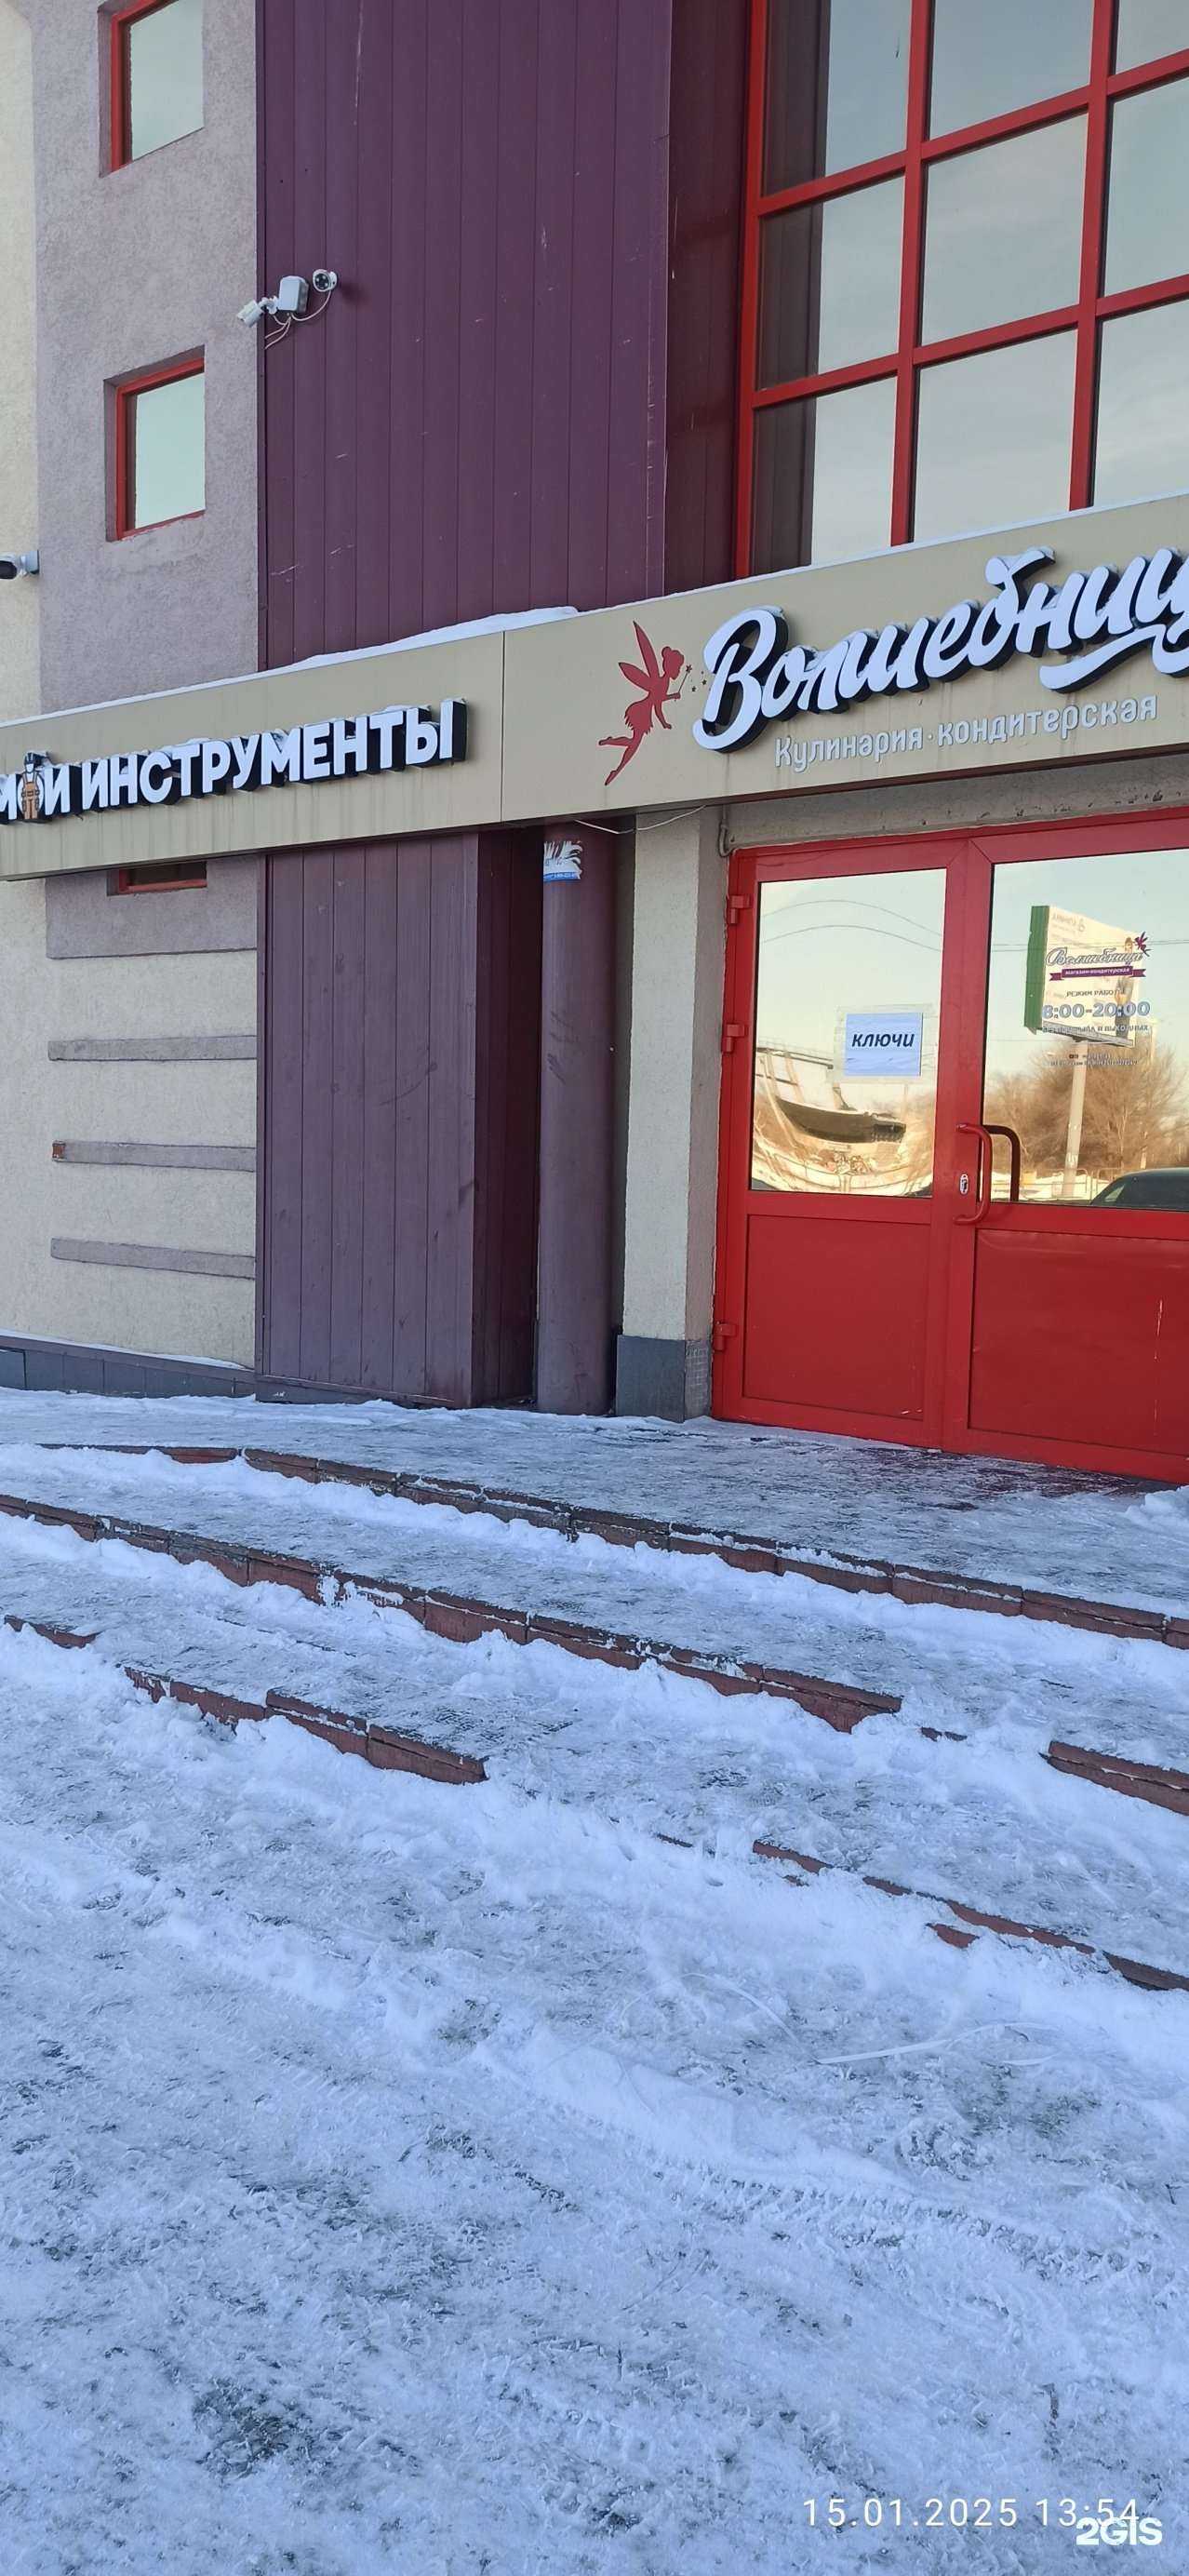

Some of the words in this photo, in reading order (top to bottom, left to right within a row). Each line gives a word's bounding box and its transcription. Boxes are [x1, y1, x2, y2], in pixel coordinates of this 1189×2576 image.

[82, 698, 463, 811] ИНСТРУМЕНТЫ
[774, 725, 924, 774] Кулинария
[937, 694, 1159, 750] кондитерская
[1042, 1000, 1151, 1020] 8:00-20:00
